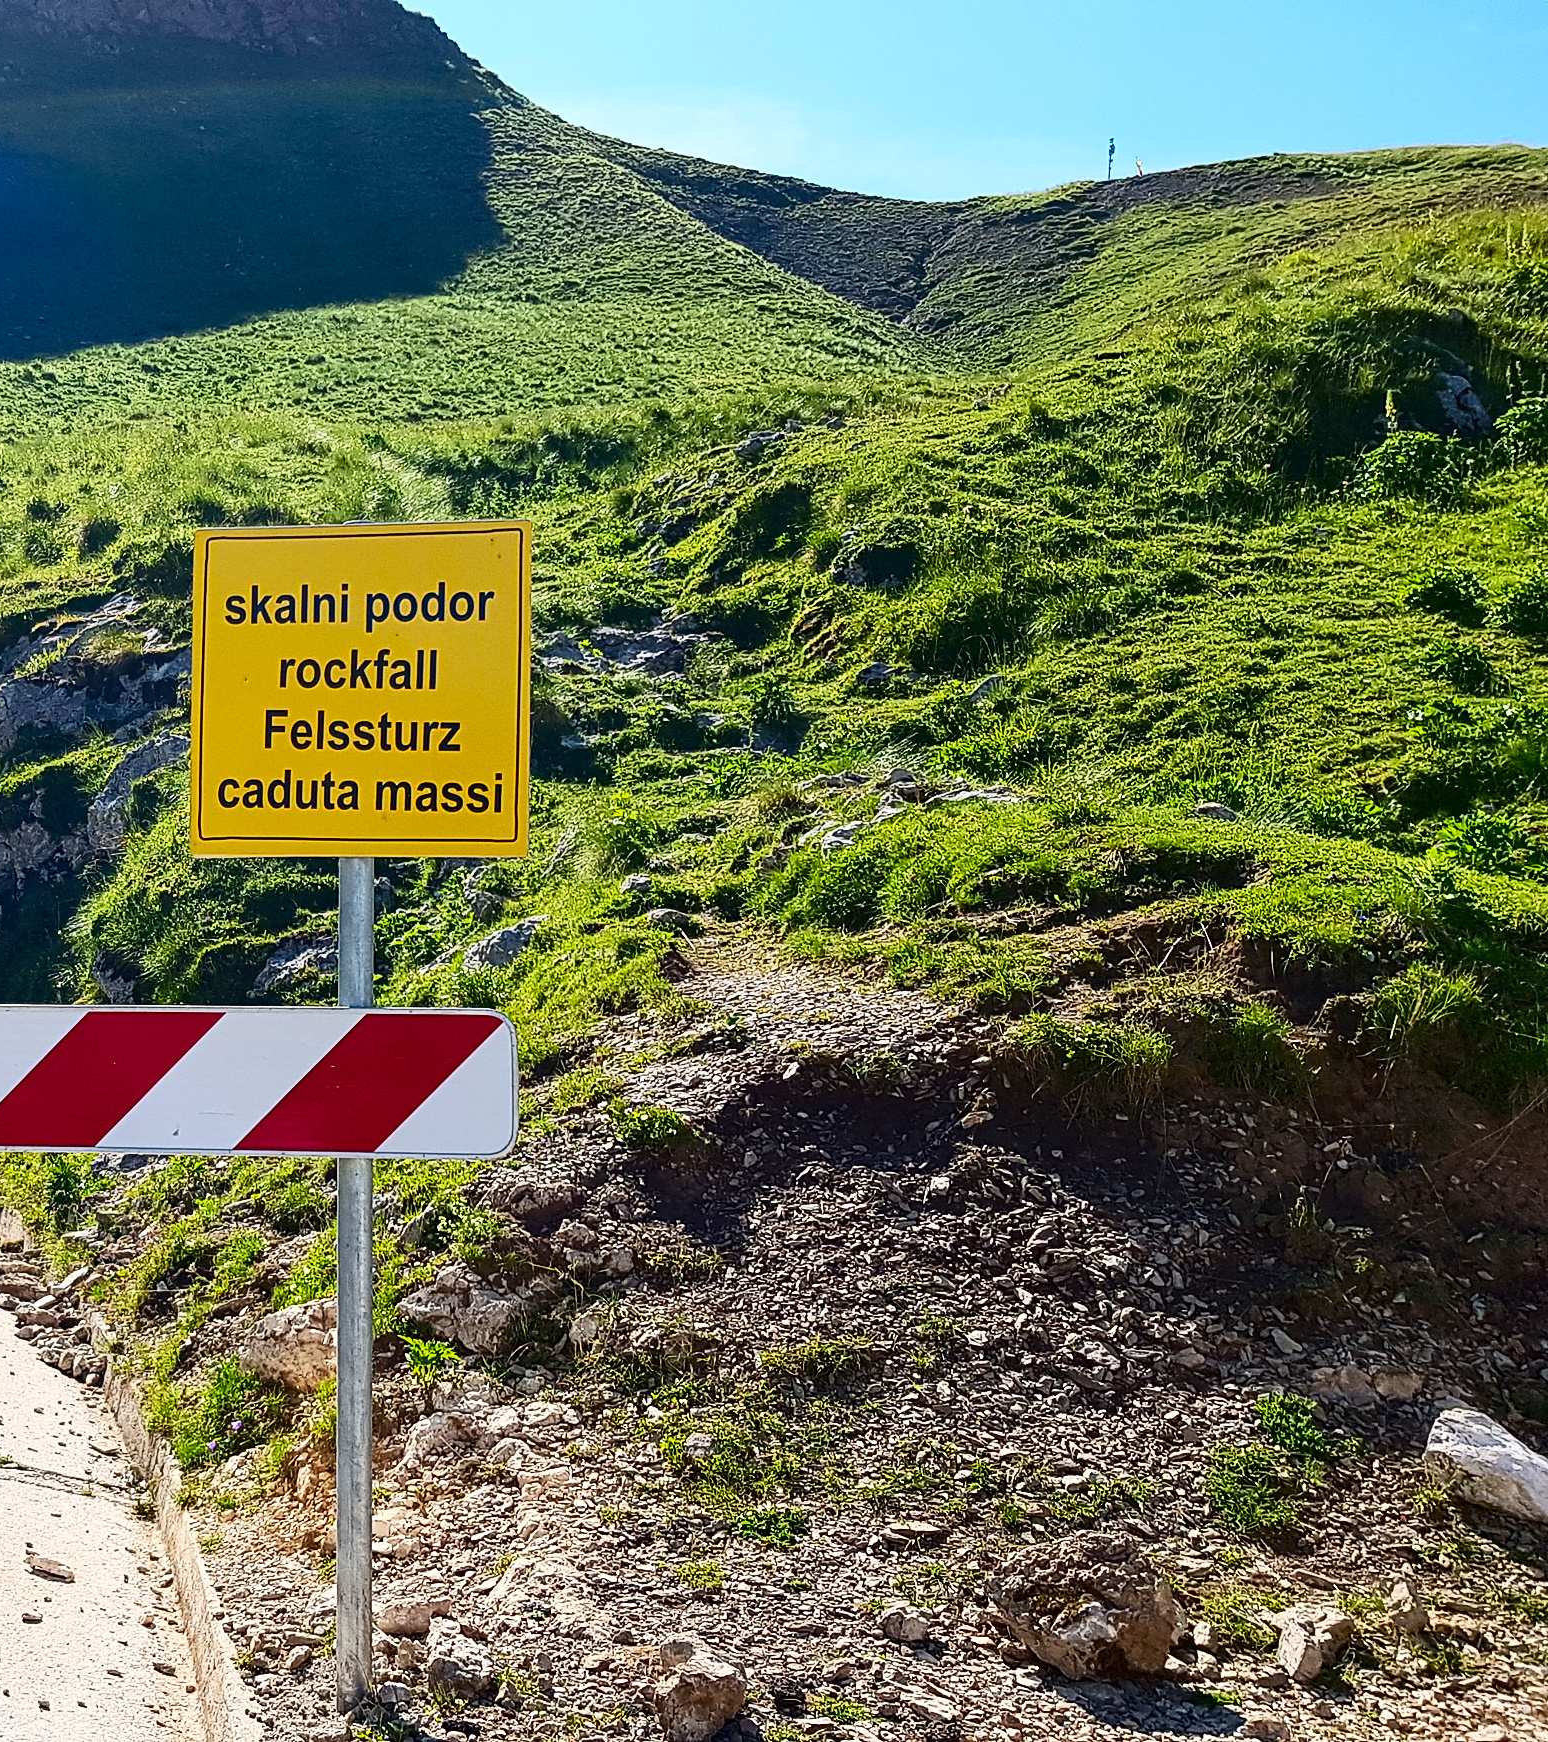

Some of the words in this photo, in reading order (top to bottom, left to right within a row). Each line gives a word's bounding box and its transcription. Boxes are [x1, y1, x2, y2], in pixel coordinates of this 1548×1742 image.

[224, 583, 349, 625] skalni
[365, 581, 495, 633] podor
[278, 648, 438, 690] rockfall
[263, 709, 462, 752] Felssturz
[217, 769, 360, 811] caduta
[375, 772, 503, 814] massi
